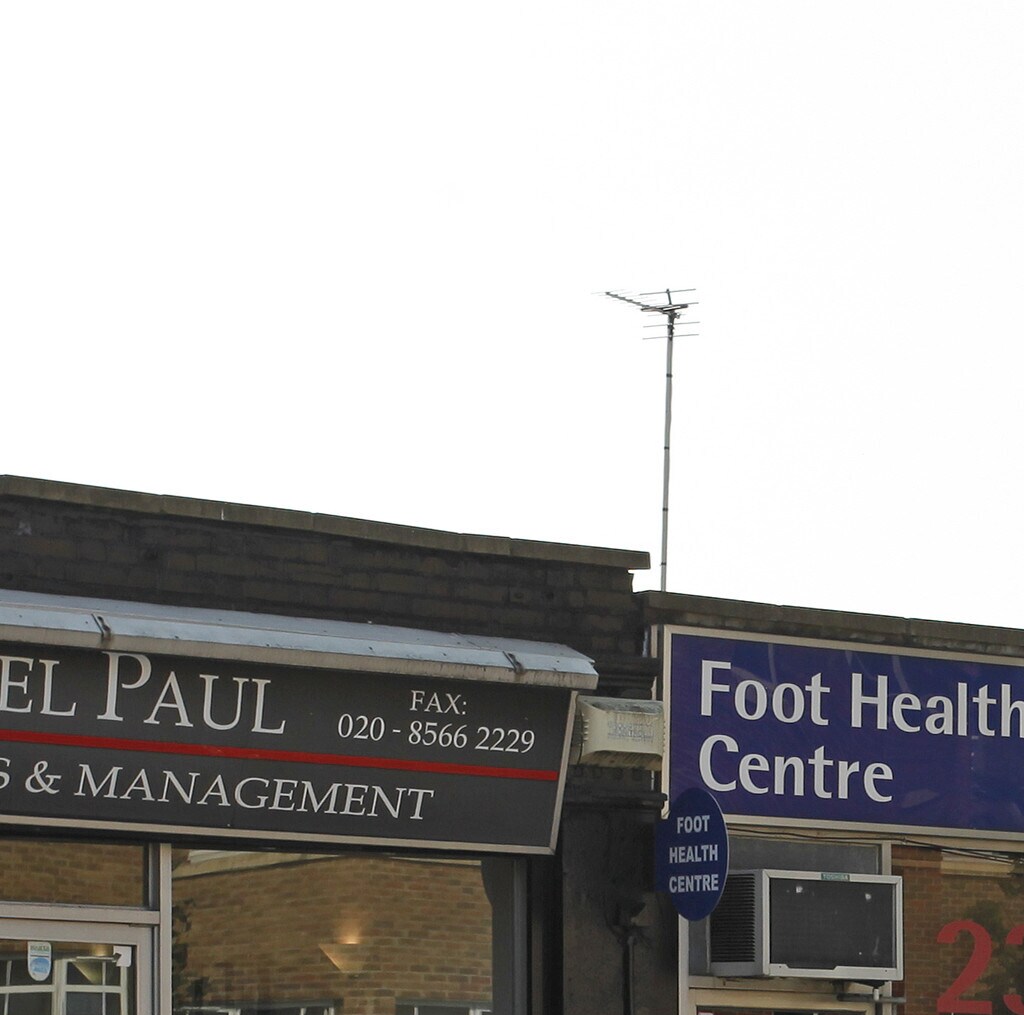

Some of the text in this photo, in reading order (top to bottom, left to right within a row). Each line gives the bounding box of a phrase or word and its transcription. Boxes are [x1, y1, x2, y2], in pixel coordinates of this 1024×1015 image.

[97, 652, 286, 736] PAUL
[410, 689, 467, 716] FAX:
[700, 660, 830, 727] Foot
[337, 714, 383, 741] 020
[408, 719, 468, 749] 8566
[475, 726, 536, 754] 2229
[699, 734, 894, 803] Centre
[25, 761, 61, 795] &
[75, 763, 435, 821] MANAGEMENT
[676, 814, 710, 834] FOOT
[669, 844, 719, 864] HEALTH
[668, 873, 719, 894] CENTRE
